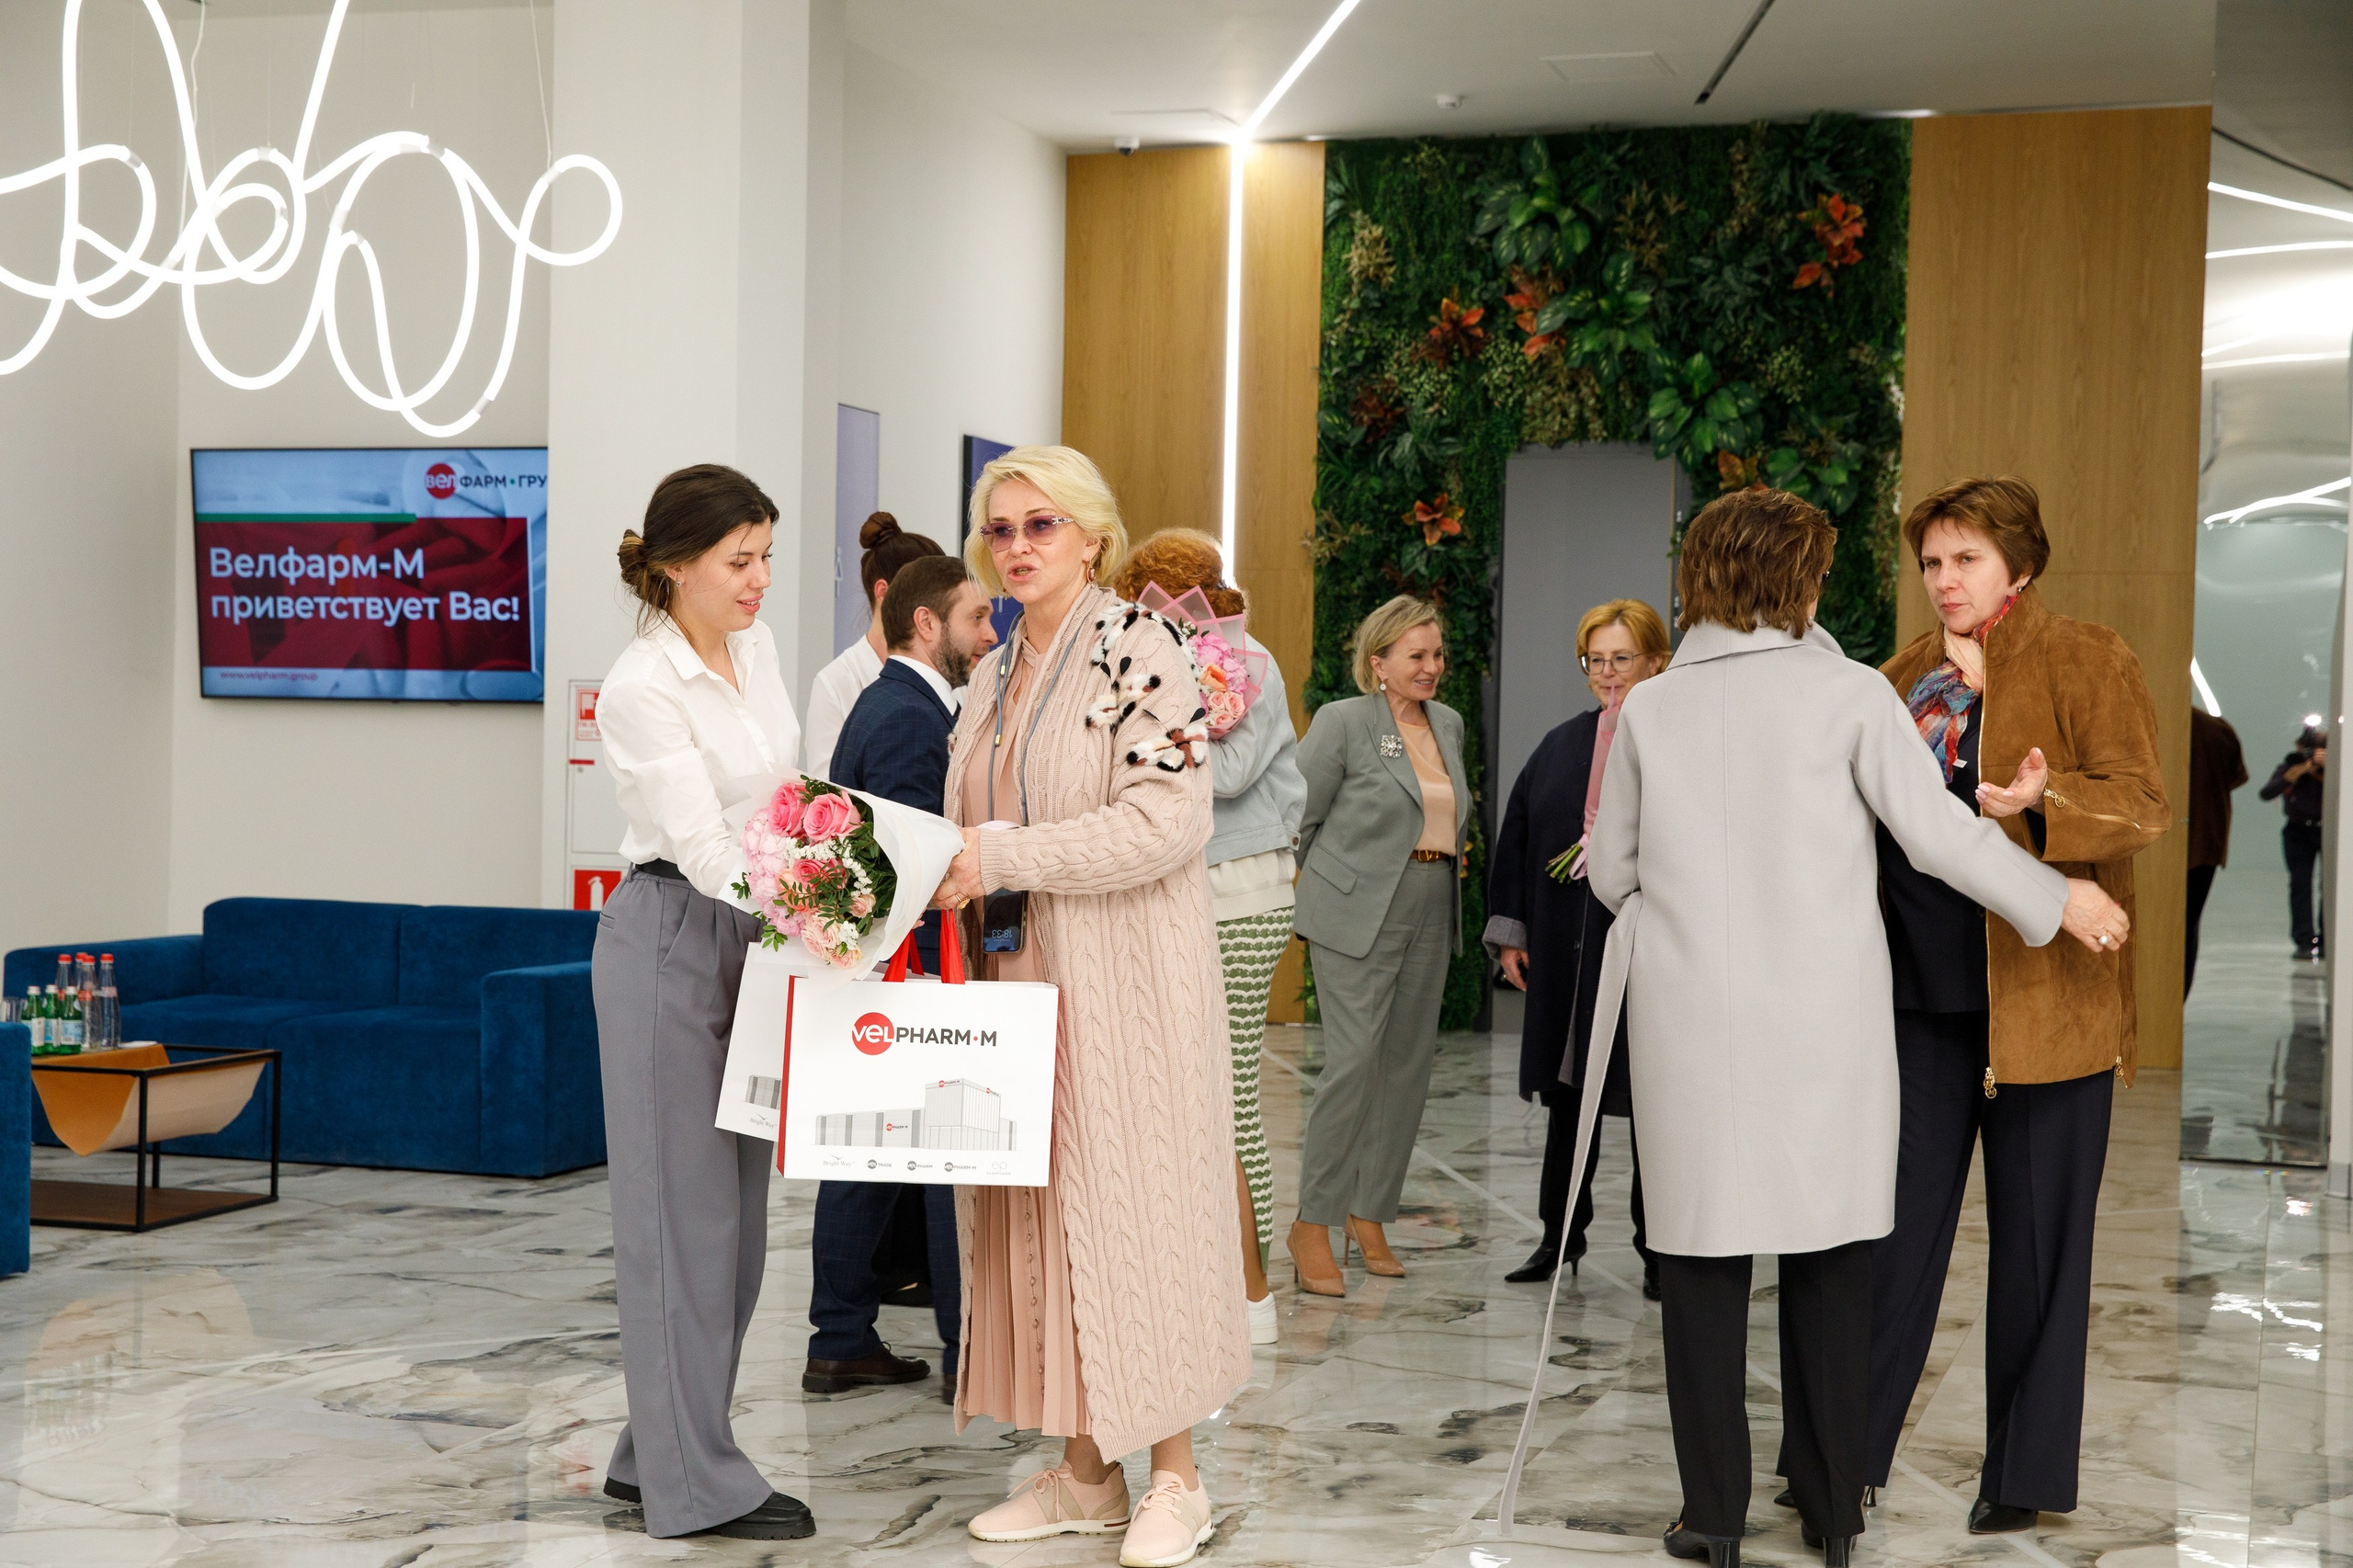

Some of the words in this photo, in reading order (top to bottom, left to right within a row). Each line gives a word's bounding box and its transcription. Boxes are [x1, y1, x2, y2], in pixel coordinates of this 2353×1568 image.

[210, 546, 424, 585] Велфарм-М
[211, 596, 440, 627] приветствует
[449, 591, 520, 620] Вас!
